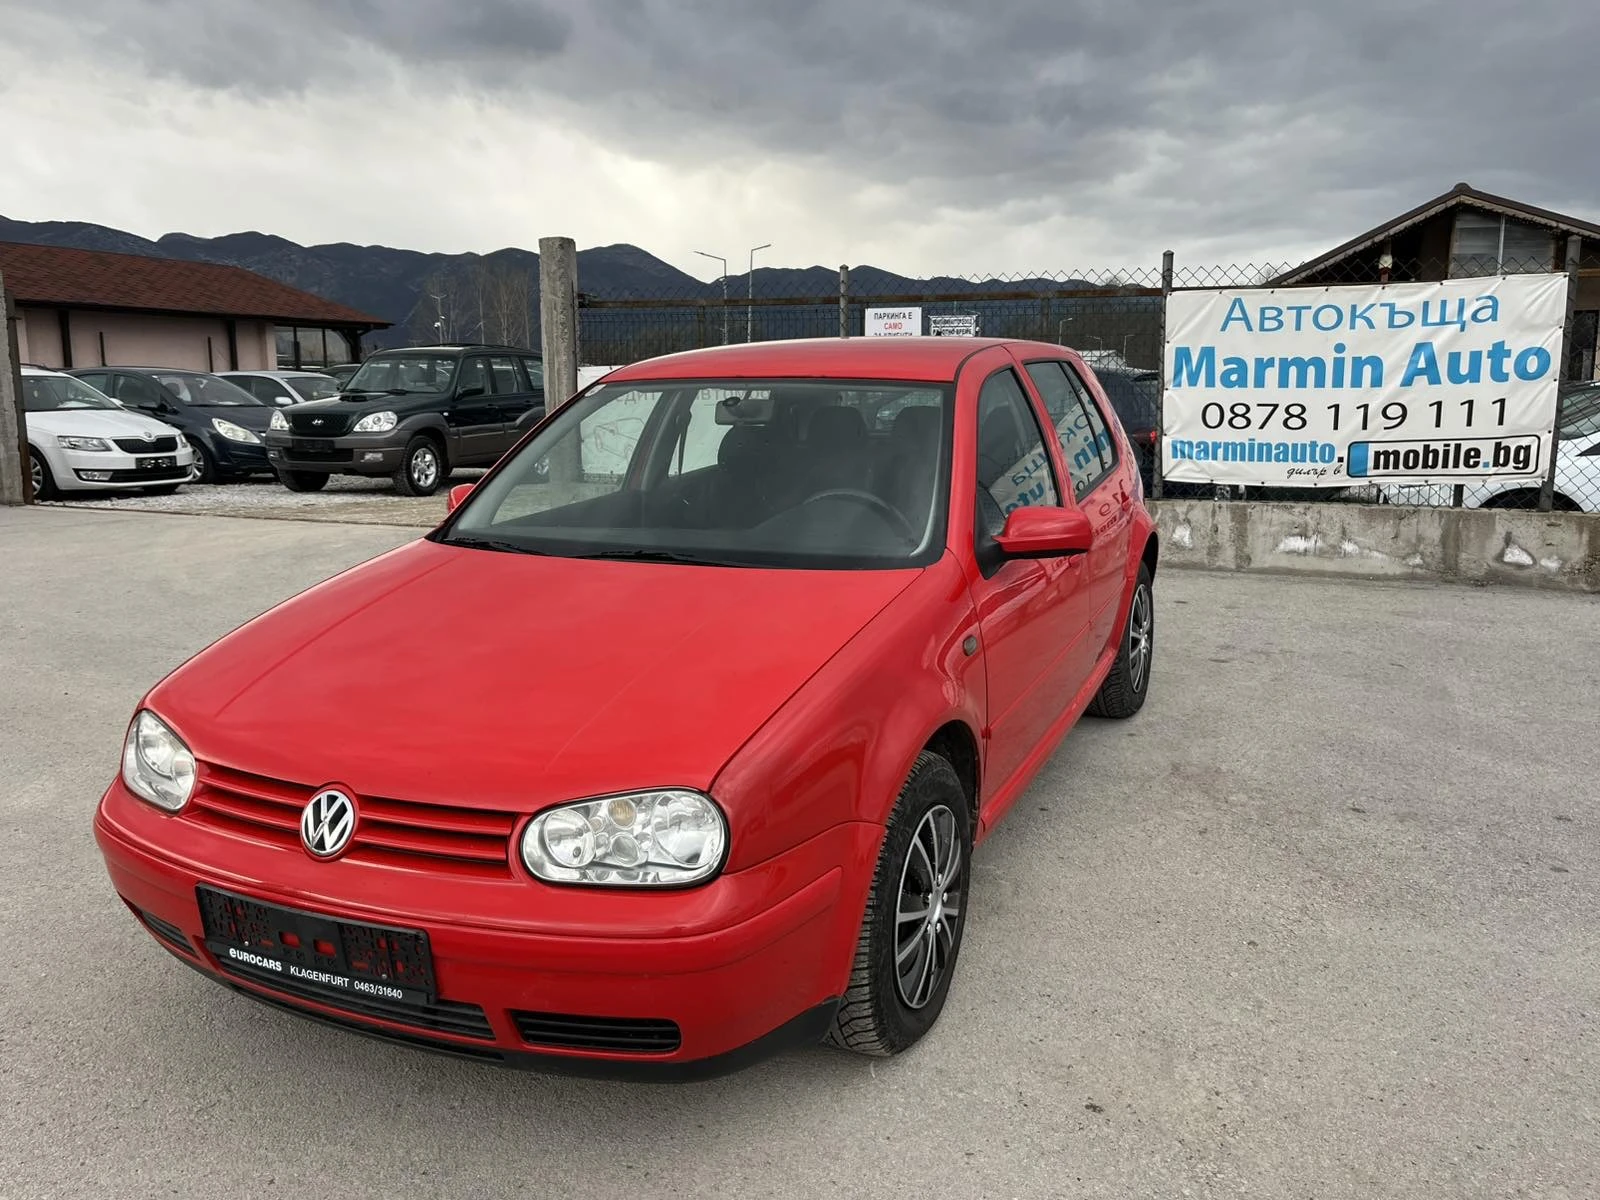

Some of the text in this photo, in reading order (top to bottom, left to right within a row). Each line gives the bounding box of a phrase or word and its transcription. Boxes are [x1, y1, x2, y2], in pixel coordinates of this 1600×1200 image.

[874, 311, 913, 320] ПАРКИНГА Е
[883, 322, 903, 330] САМО
[1219, 294, 1499, 332] Автокъща
[1172, 340, 1551, 389] Marmin Auto
[1201, 398, 1506, 431] 0878 119 111
[1373, 441, 1532, 470] mobile.bg
[290, 965, 350, 988] KLAGENFURT
[354, 980, 403, 999] 0463/31640
